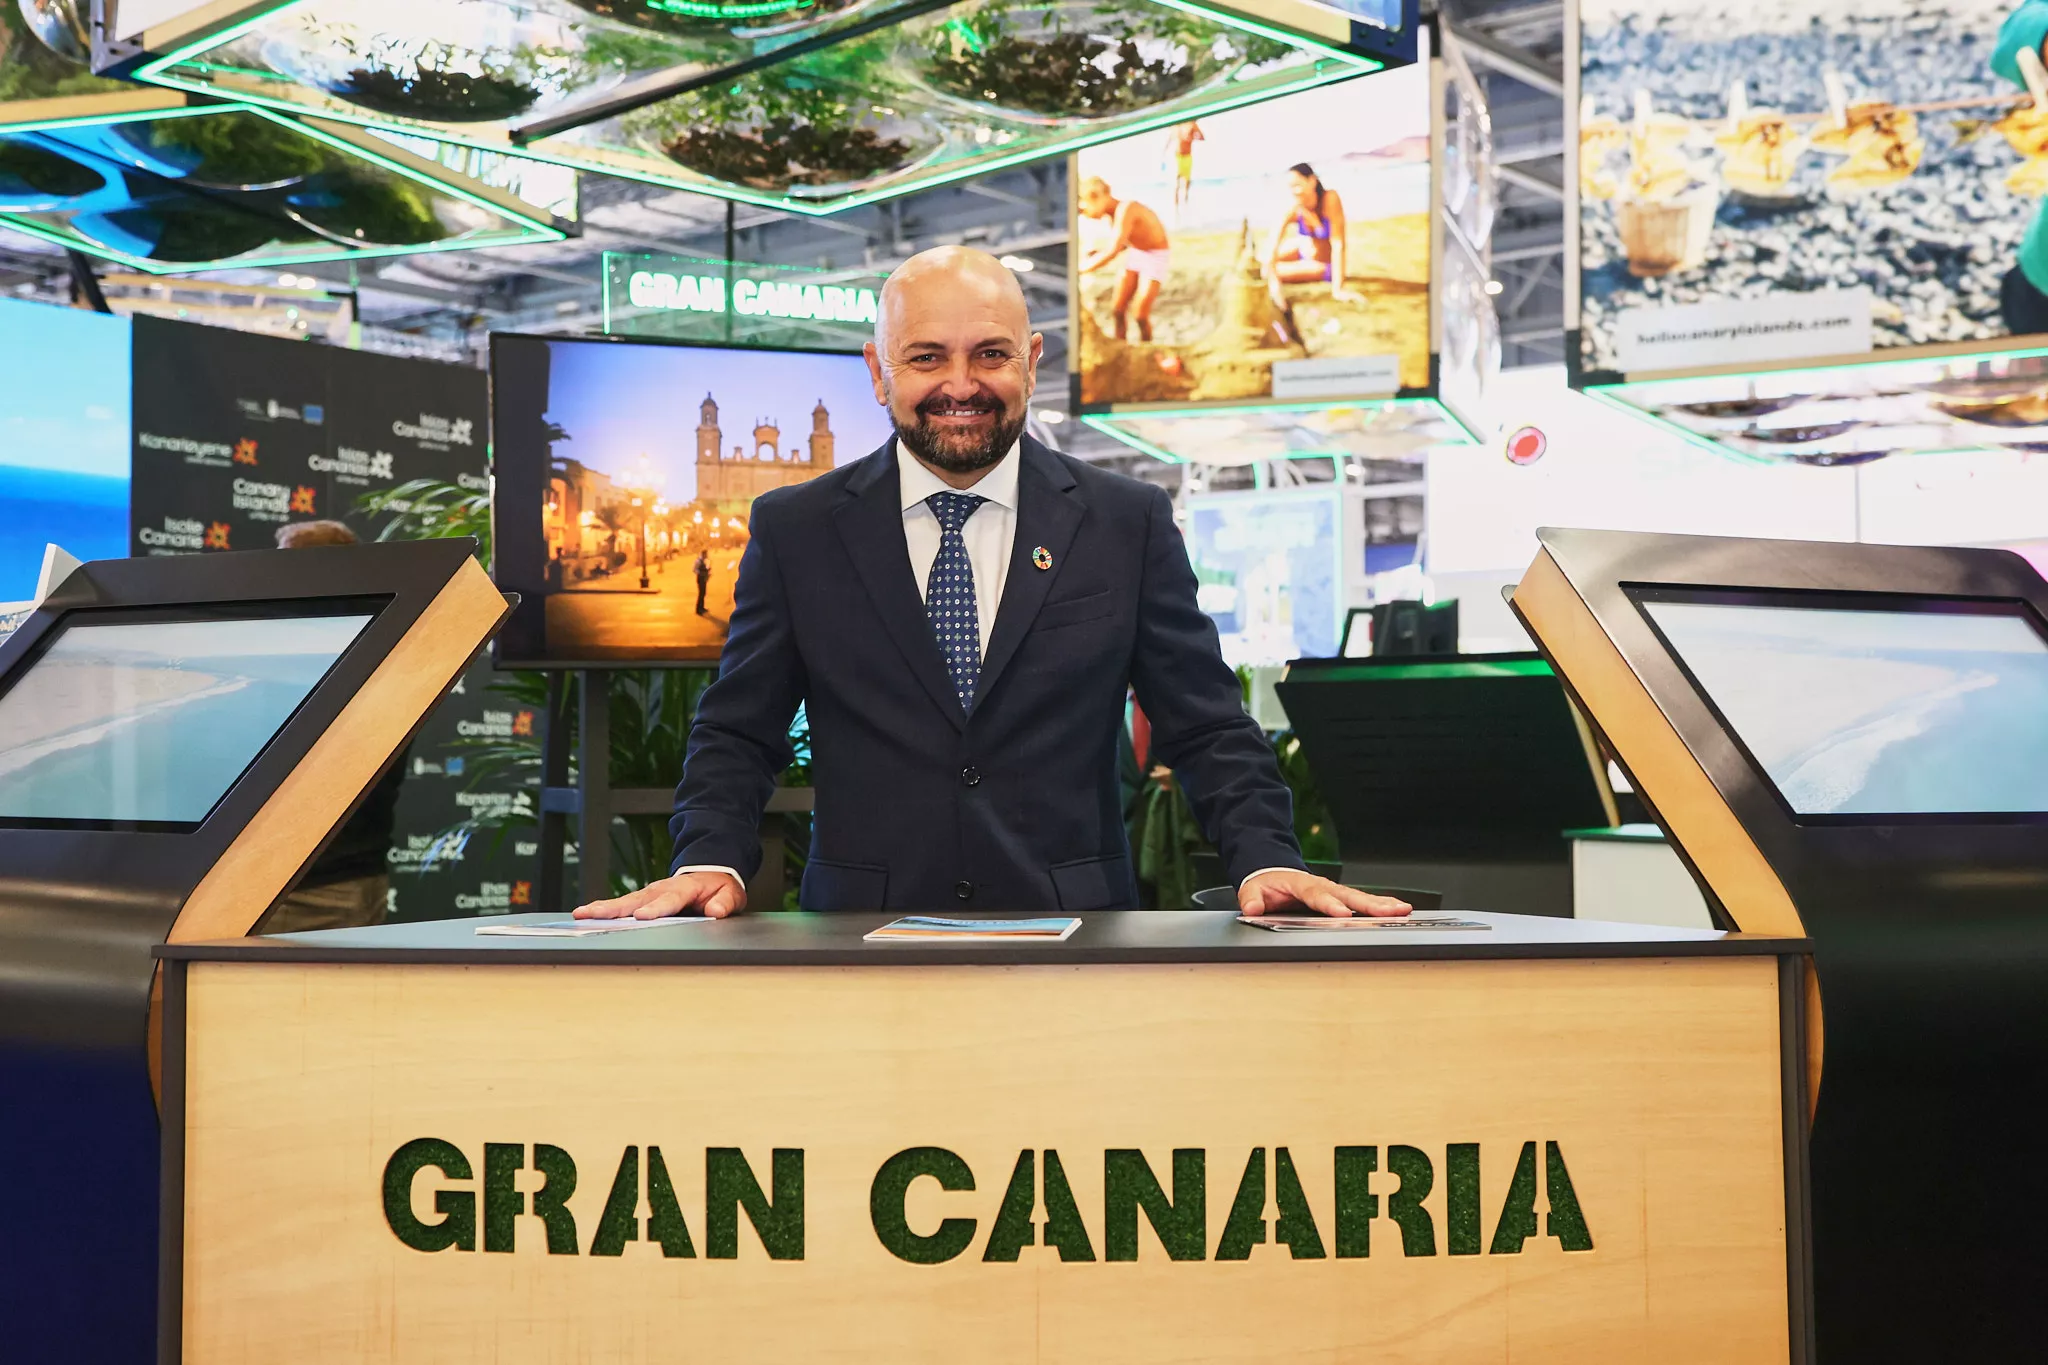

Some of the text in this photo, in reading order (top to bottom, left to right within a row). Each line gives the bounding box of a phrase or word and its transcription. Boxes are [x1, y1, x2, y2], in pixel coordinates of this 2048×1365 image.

[629, 271, 877, 323] GRAN CANARIA
[233, 478, 291, 501] Canary
[233, 493, 291, 514] Islands
[382, 1137, 1595, 1265] GRAN CANARIA
